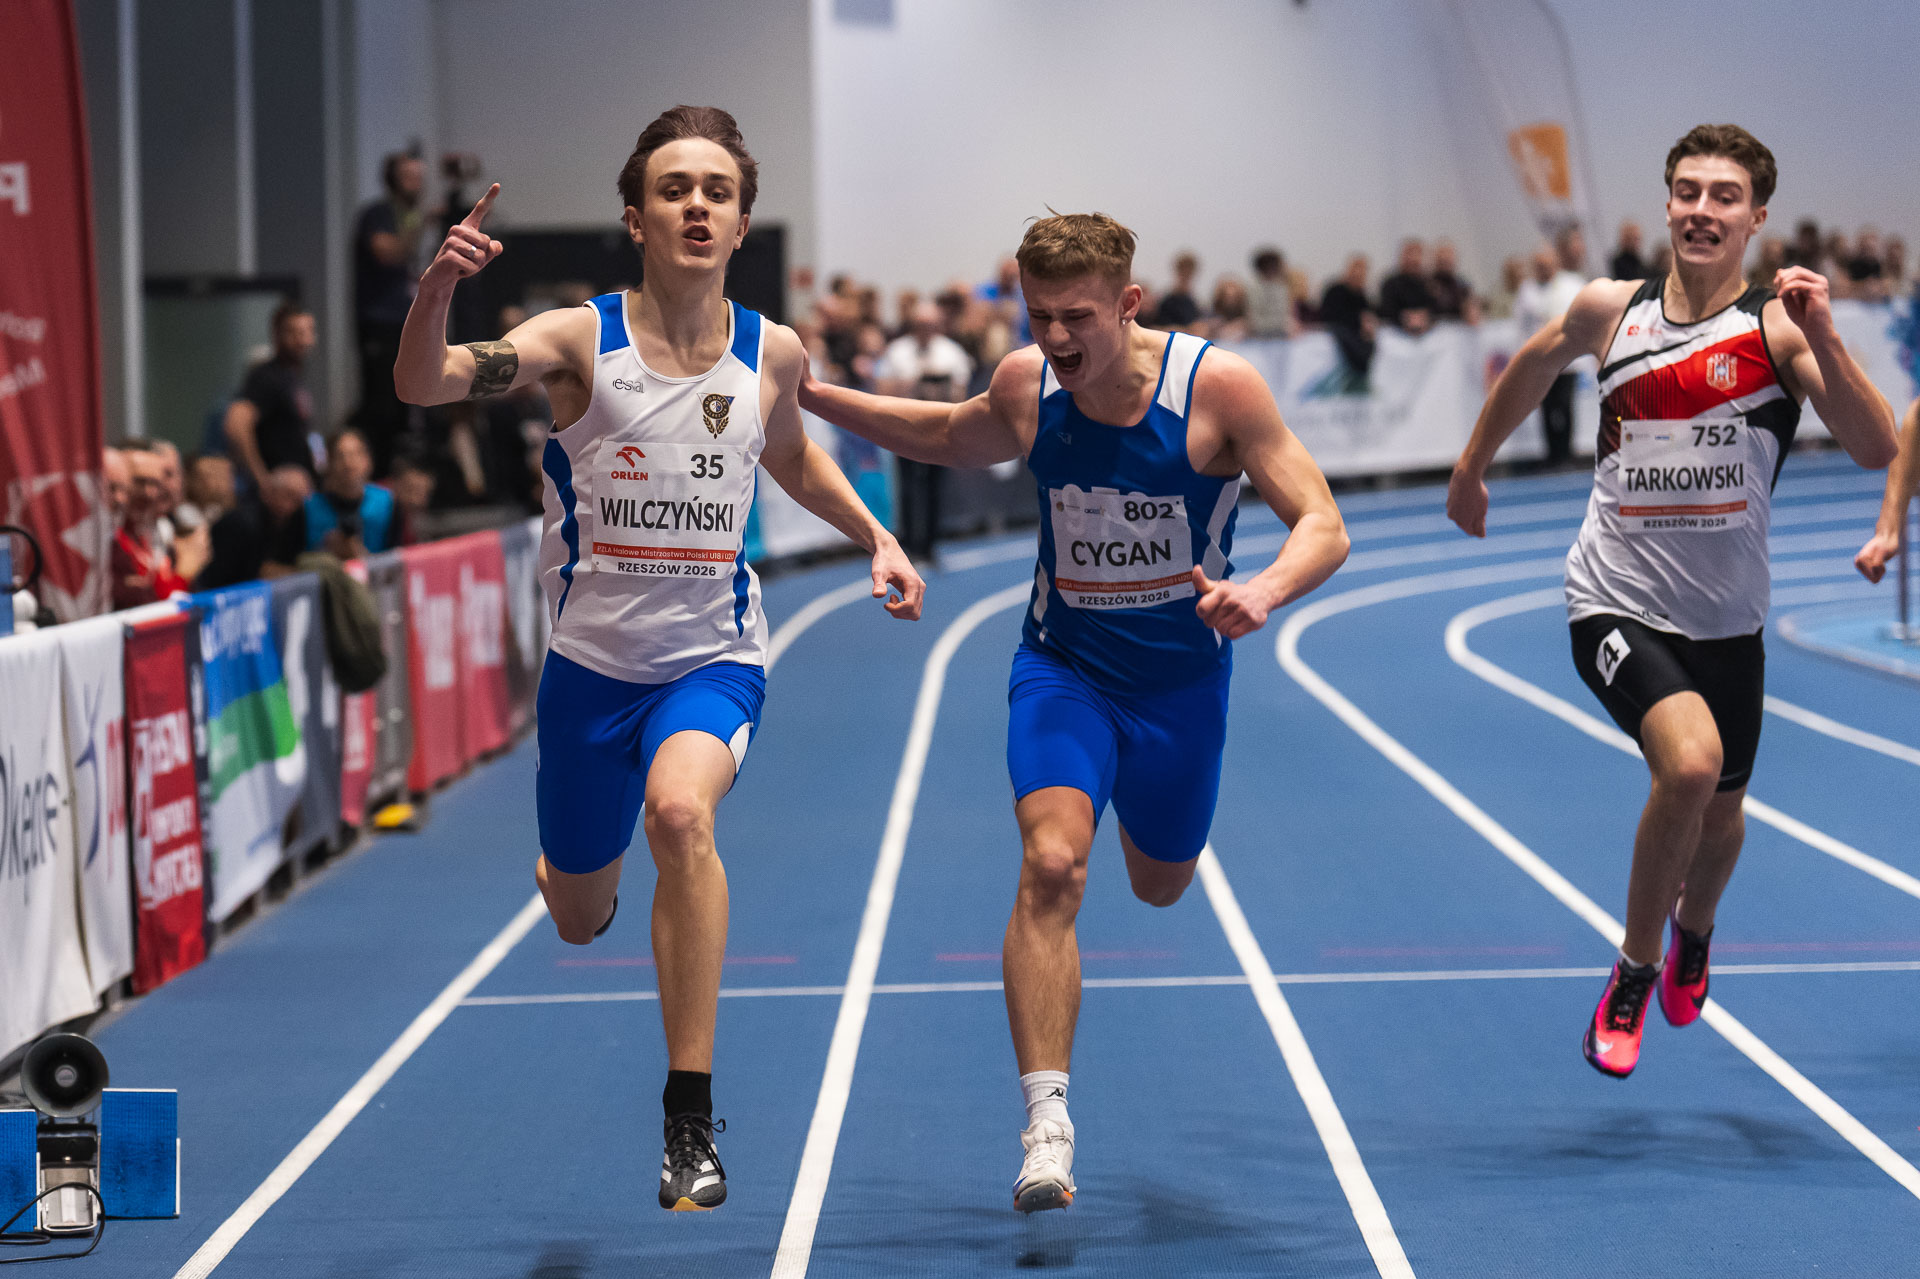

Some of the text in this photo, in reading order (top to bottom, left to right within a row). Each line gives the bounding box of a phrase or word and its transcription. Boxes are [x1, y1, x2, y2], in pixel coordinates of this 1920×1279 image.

[1692, 424, 1737, 447] 752
[610, 469, 649, 481] ORLEN
[689, 453, 724, 480] 35
[1625, 463, 1744, 492] TARKOWSKI
[600, 495, 734, 532] WILCZYŃSKI
[1123, 500, 1176, 522] 802
[1643, 516, 1698, 529] RZESZÓW
[597, 546, 612, 554] PZLA
[613, 547, 639, 556] Halowe
[640, 549, 685, 558] Mistrzostwa
[686, 551, 708, 559] Polski
[709, 552, 722, 560] U18
[1070, 538, 1172, 567] CYGAN
[617, 561, 717, 576] RZESZÓW 2026
[1079, 590, 1170, 606] RZESZÓW 2026
[1603, 640, 1620, 673] 4
